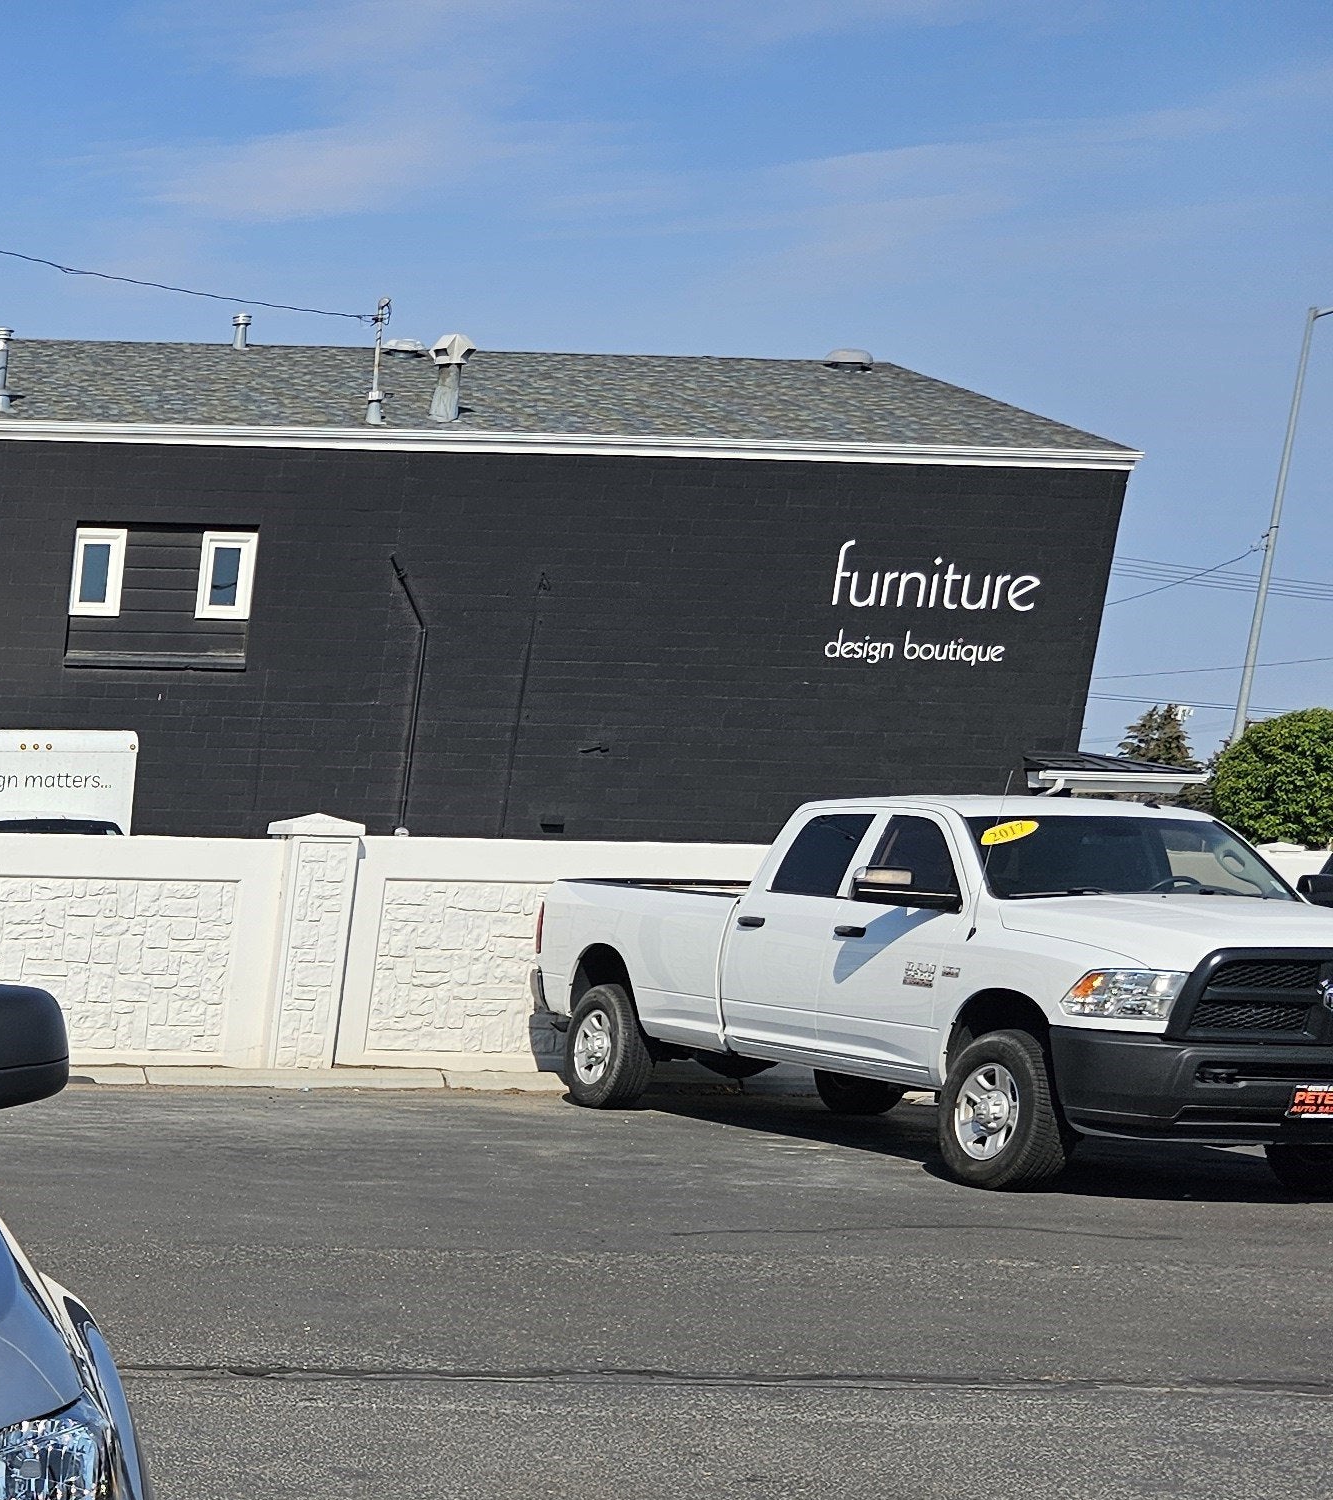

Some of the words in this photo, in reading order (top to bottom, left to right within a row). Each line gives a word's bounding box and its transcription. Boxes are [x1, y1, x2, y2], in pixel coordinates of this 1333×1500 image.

[832, 539, 1041, 611] furniture
[824, 628, 894, 663] design
[903, 630, 1006, 666] boutique
[24, 772, 112, 789] matters...
[988, 822, 1025, 842] 2017
